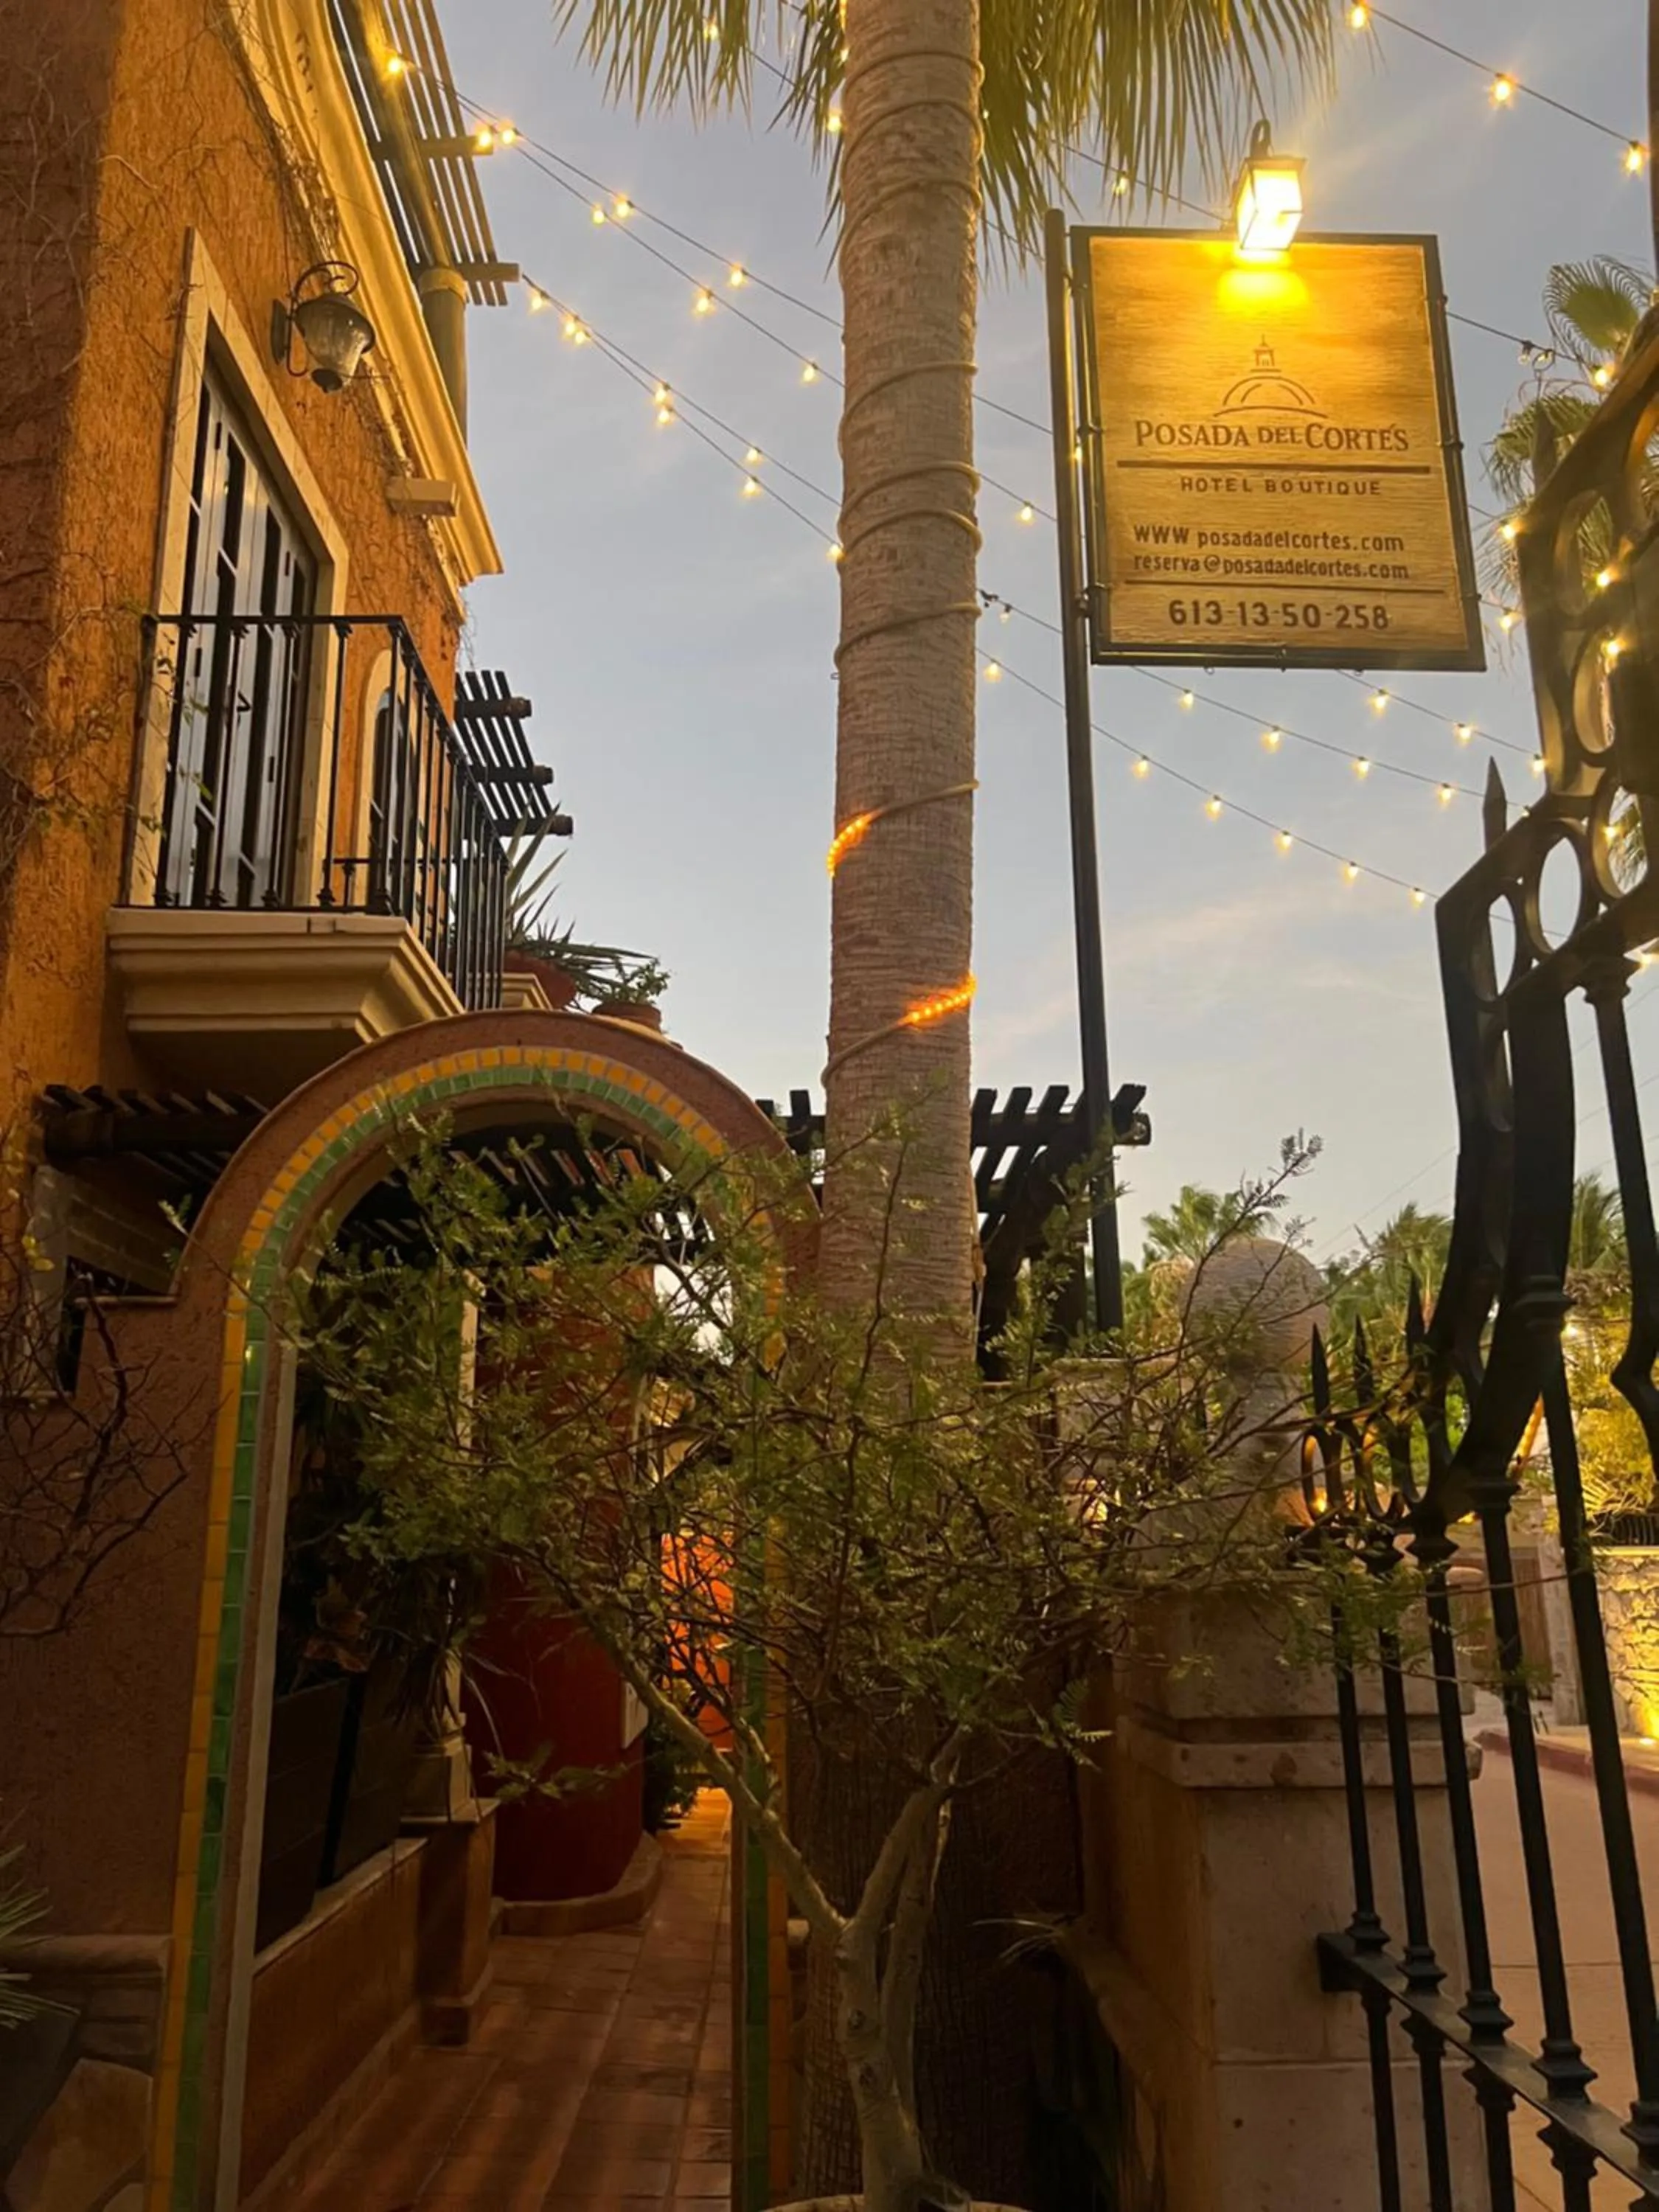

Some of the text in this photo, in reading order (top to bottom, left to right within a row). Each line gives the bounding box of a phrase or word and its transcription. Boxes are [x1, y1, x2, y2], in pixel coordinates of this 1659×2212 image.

[1135, 420, 1409, 451] POSADA DEL CORTÉS
[1180, 477, 1381, 495] HOTEL BOUTIQUE
[1197, 529, 1405, 552] posadadelcortes.com
[1133, 554, 1410, 580] reserva@posadadelcortes.com
